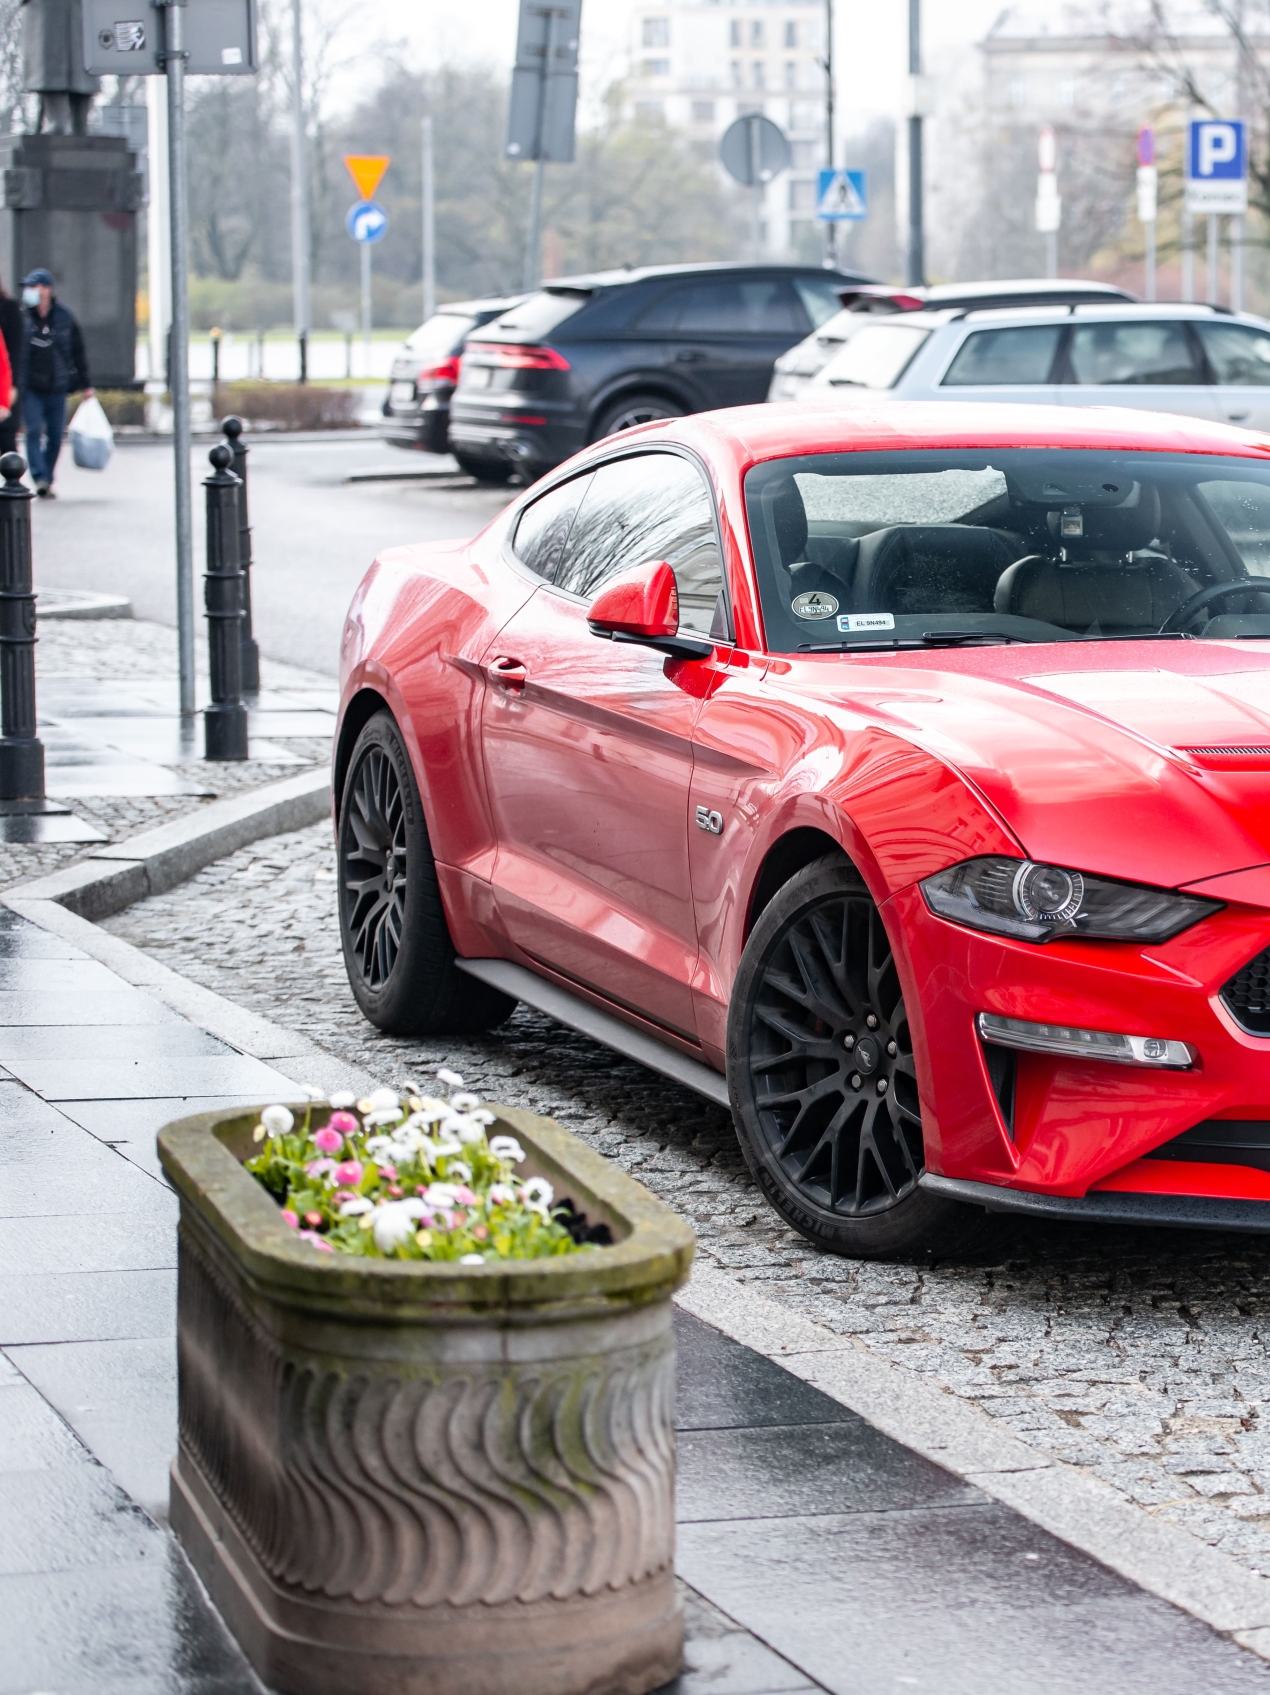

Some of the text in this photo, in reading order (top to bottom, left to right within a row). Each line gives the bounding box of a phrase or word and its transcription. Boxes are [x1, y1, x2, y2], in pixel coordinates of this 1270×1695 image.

[1199, 124, 1237, 175] P
[808, 593, 821, 605] 4
[695, 804, 723, 835] 5.0
[760, 1172, 835, 1240] MICHELIN
